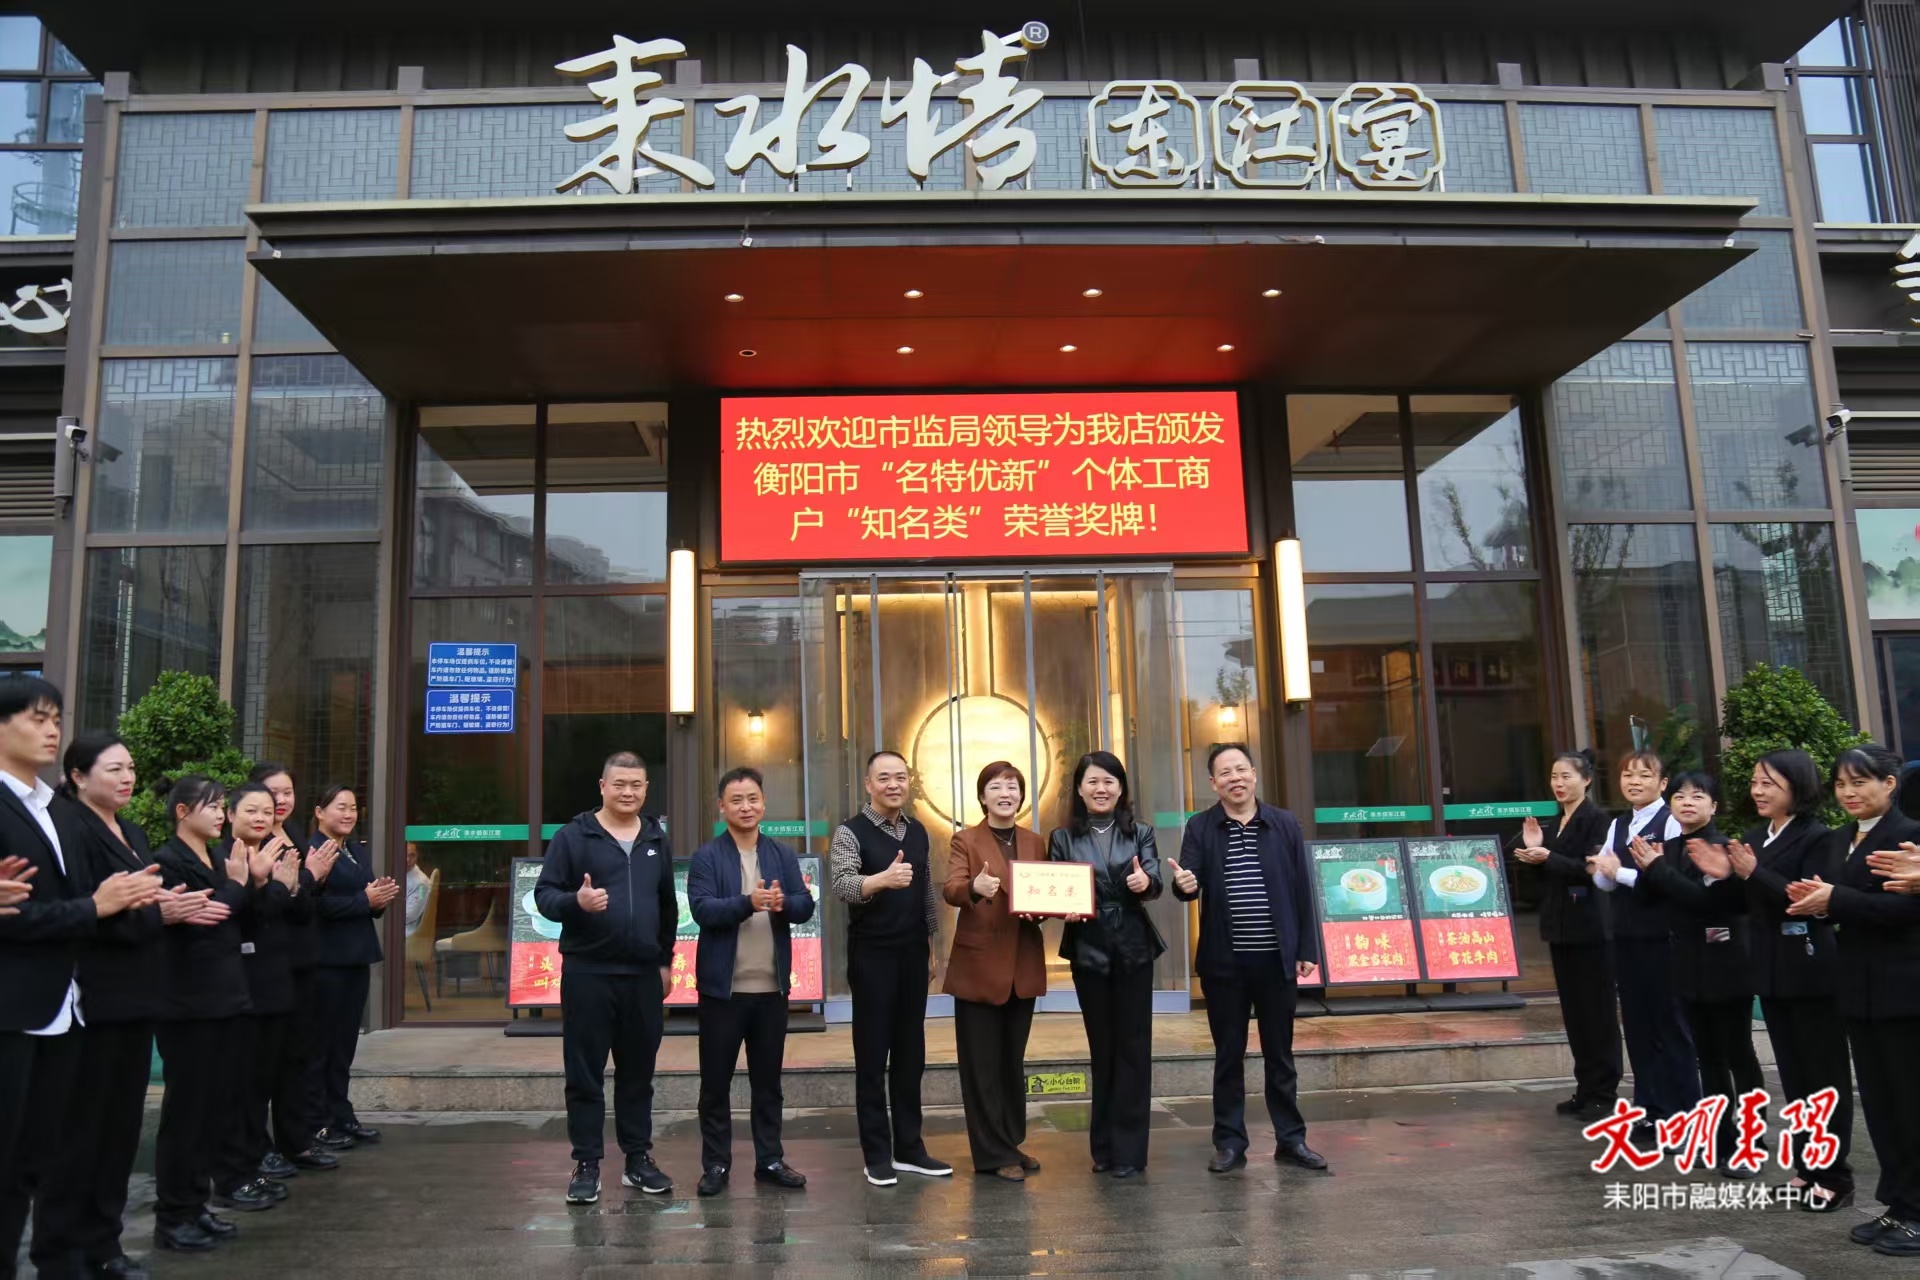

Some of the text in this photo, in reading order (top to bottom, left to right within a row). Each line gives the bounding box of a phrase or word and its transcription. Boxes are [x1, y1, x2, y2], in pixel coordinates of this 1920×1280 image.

[554, 30, 1432, 195] 耒水情 东江宴
[735, 411, 1225, 451] 热烈欢迎市监局领导为我店颁发
[456, 647, 490, 656] 温馨提示
[449, 693, 491, 704] 温馨提示
